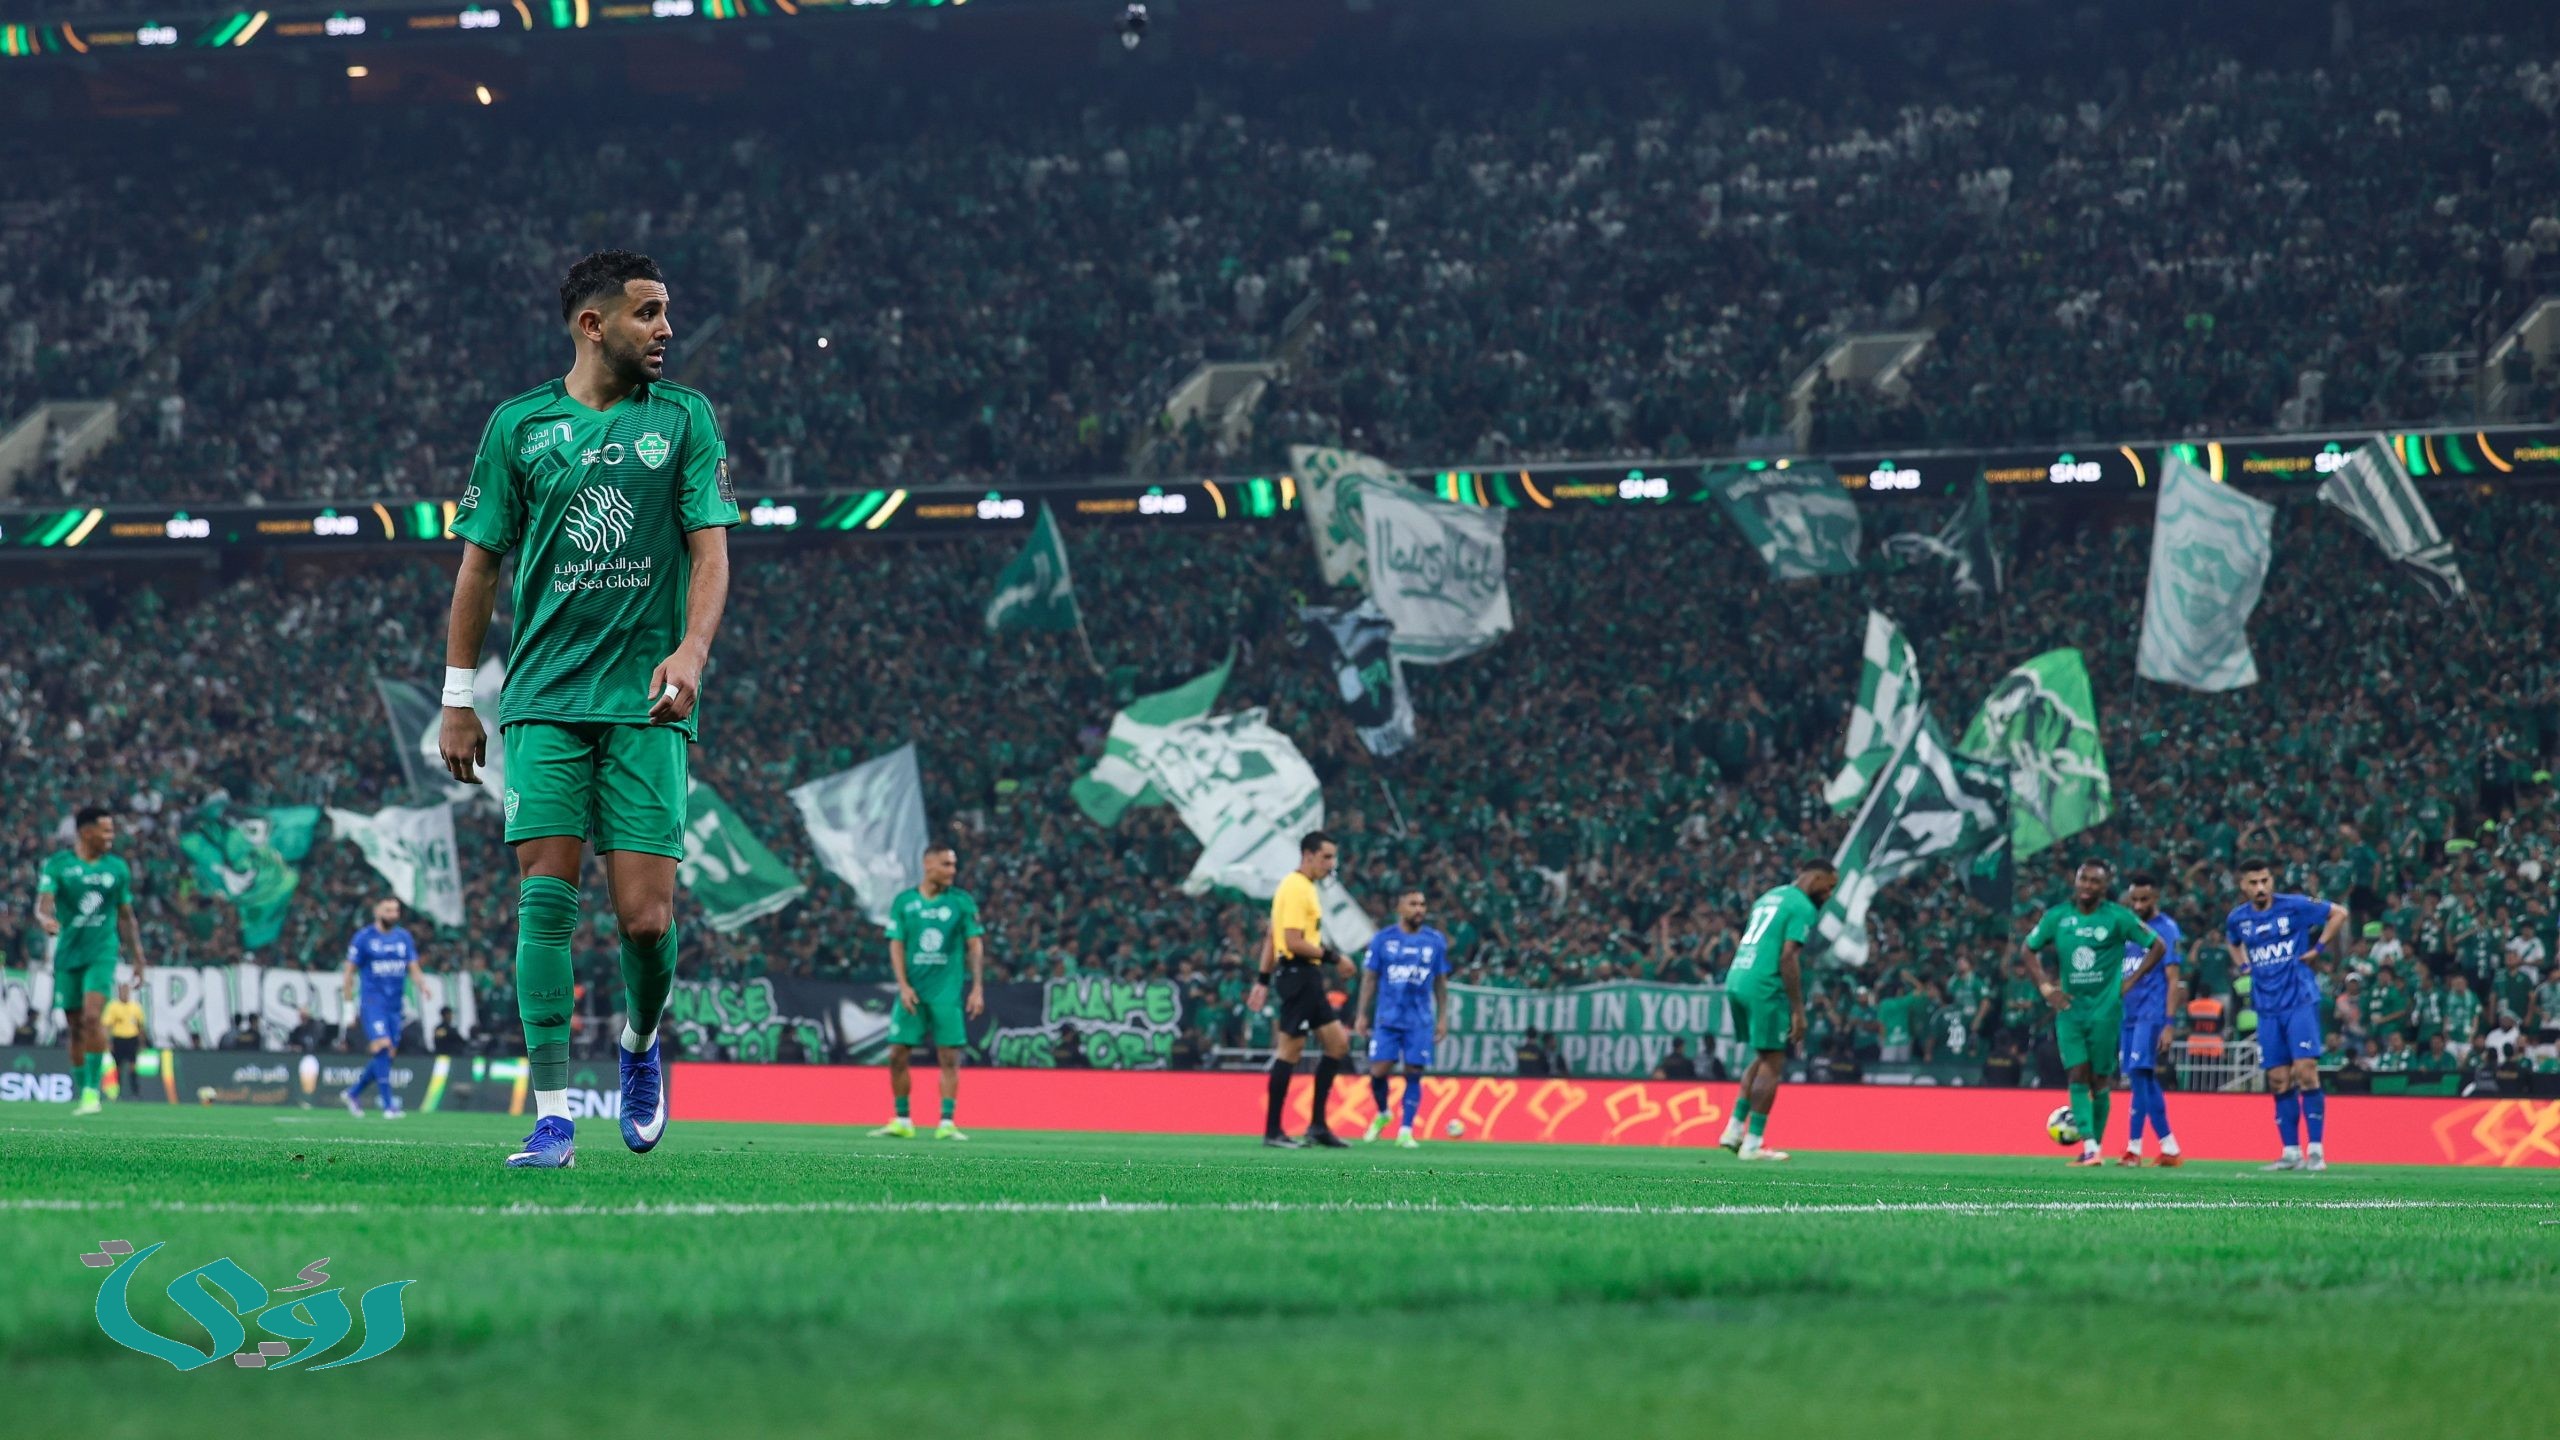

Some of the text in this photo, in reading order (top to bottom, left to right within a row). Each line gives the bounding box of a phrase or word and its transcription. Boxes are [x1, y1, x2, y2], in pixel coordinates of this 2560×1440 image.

[527, 429, 549, 443] الديار
[520, 440, 550, 455] العربية
[581, 456, 600, 466] SIRC
[2315, 452, 2352, 473] SN
[1869, 469, 1921, 490] SNB
[2050, 462, 2101, 483] SNB
[1619, 478, 1668, 499] SNB
[977, 499, 1024, 519] SNB
[1139, 494, 1186, 514] SNB
[313, 516, 358, 535] SNB
[751, 505, 797, 526] SNB
[166, 518, 210, 538] SNB
[554, 556, 651, 576] البحر الأحمر الدولية
[554, 573, 651, 593] Red Sea Global
[1740, 905, 1778, 945] 17
[1048, 978, 1175, 1025] MAKE
[1469, 993, 1577, 1031] FAITH
[1590, 992, 1627, 1032] IN
[1638, 993, 1709, 1033] YOU
[996, 1028, 1177, 1068] HISORY
[0, 1072, 73, 1103] SNB
